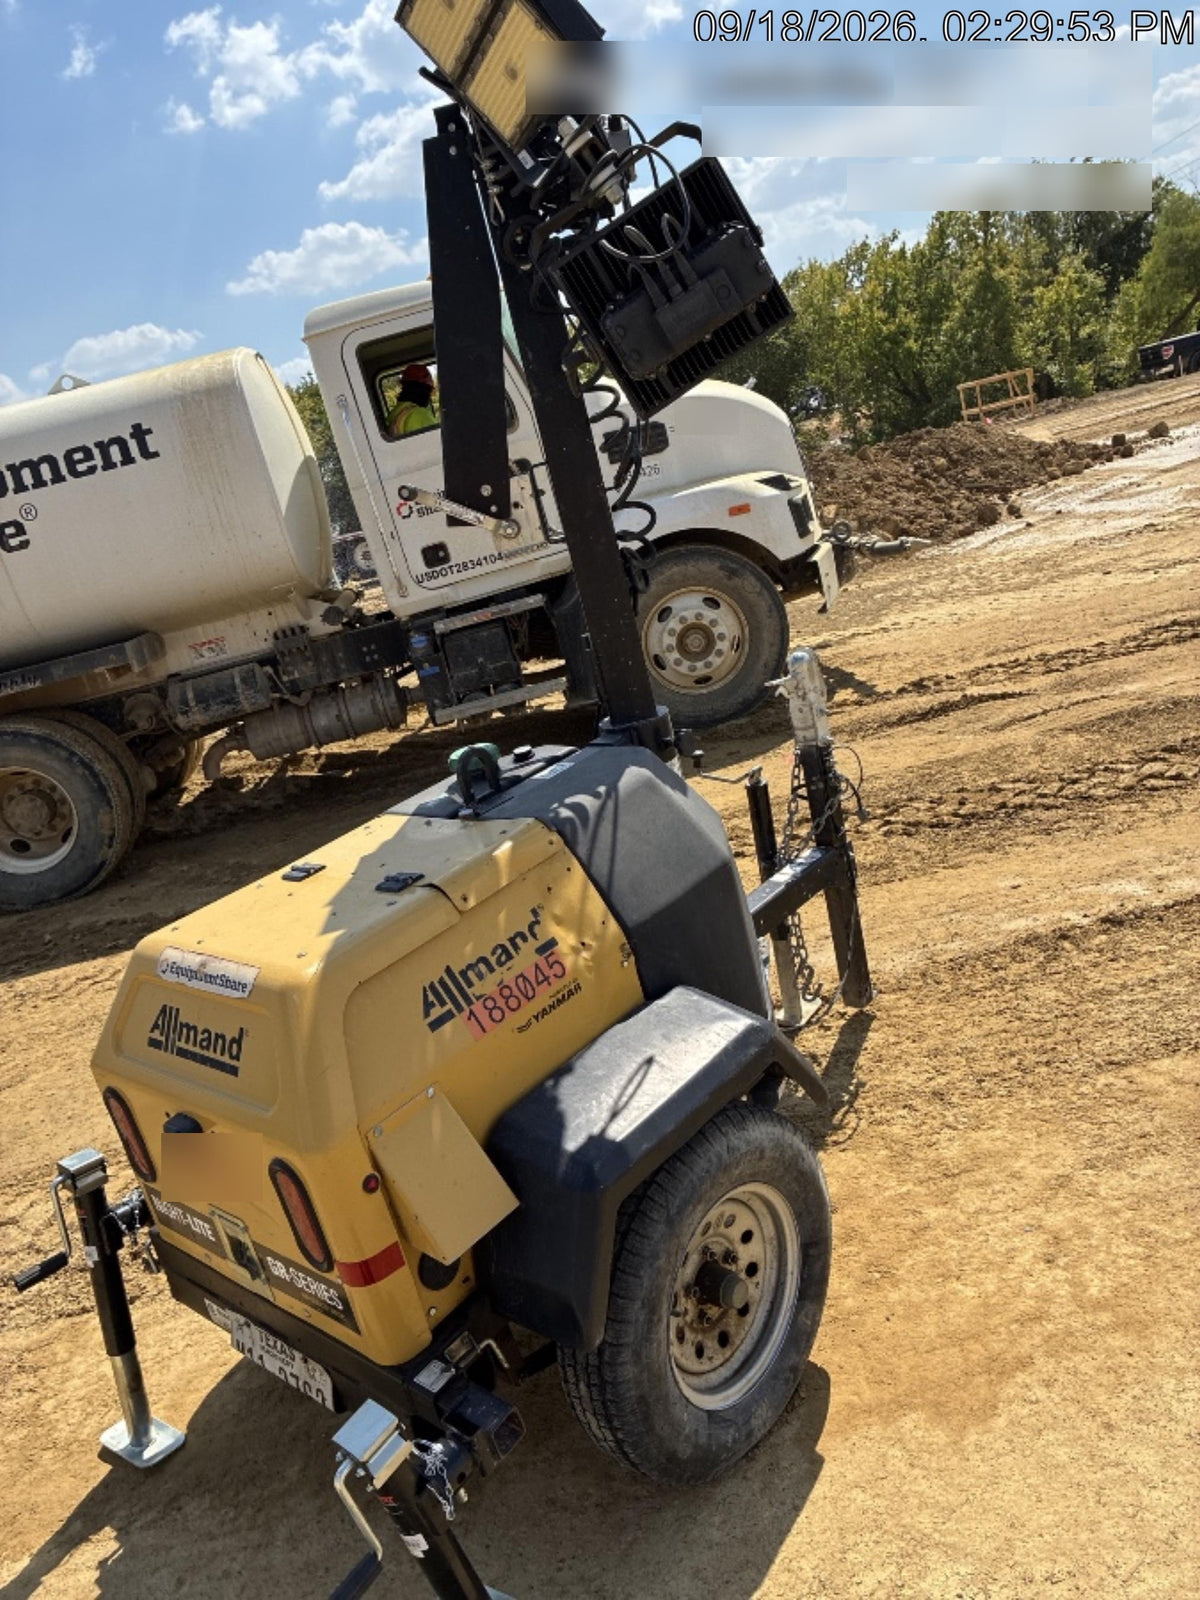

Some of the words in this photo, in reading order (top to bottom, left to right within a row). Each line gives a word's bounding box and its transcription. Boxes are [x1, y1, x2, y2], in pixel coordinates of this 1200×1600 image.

[466, 951, 567, 1034] 188045
[532, 982, 583, 1023] YANMAR
[149, 1004, 245, 1063] Allmand
